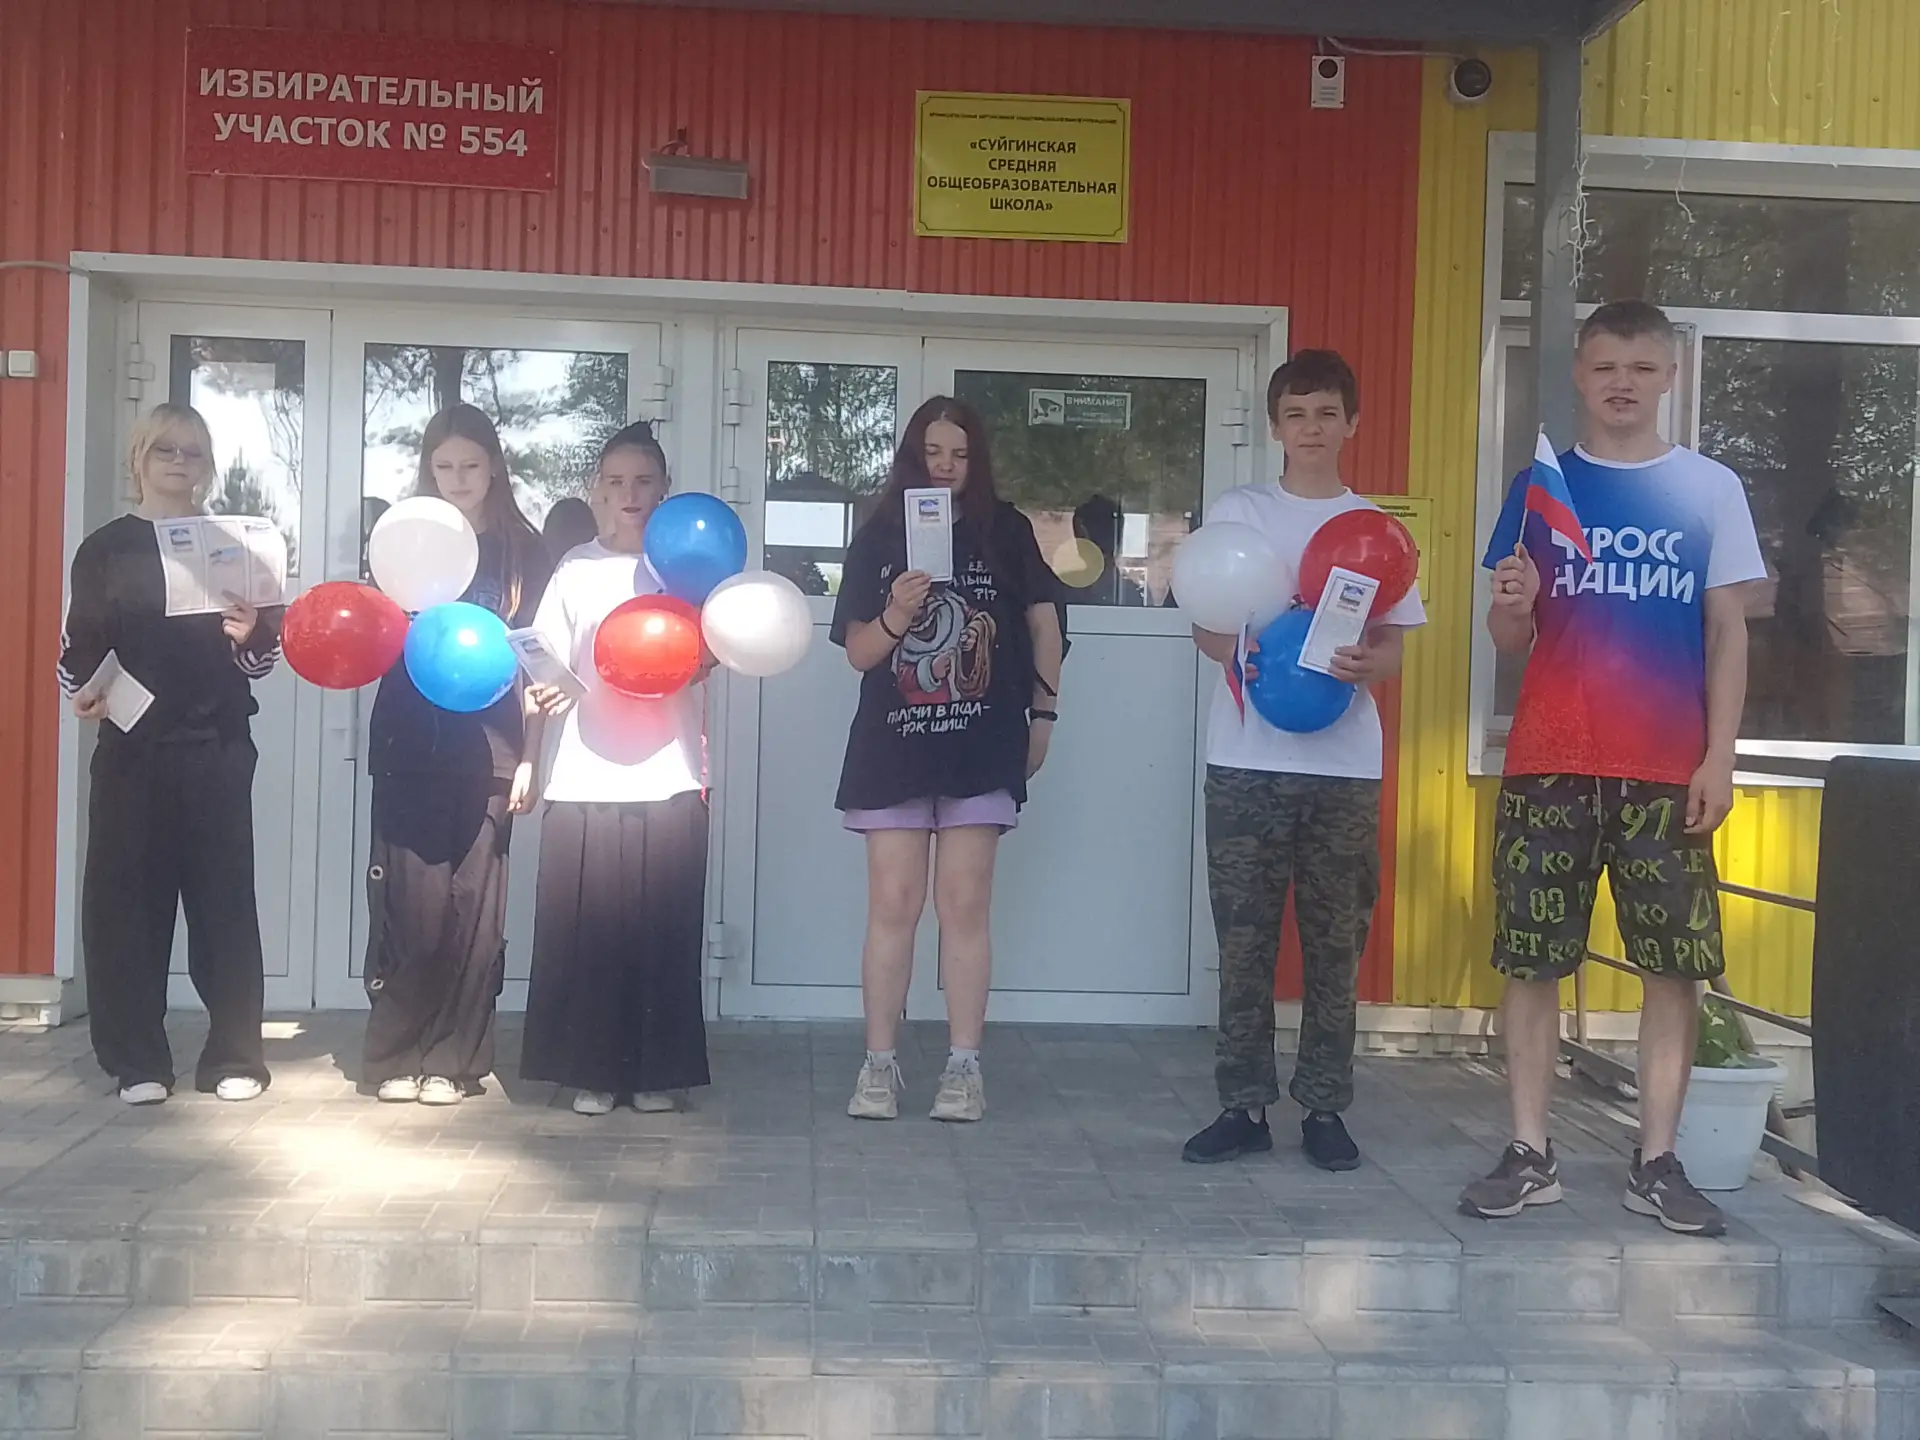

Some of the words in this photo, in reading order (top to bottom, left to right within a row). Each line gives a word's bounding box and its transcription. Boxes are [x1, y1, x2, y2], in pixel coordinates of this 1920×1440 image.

[199, 67, 544, 115] ИЗБИРАТЕЛЬНЫЙ
[213, 112, 391, 149] УЧАСТОК
[403, 121, 446, 151] №
[459, 126, 528, 157] 554
[970, 135, 1077, 154] «СУЙГИНСКАЯ
[988, 158, 1057, 174] СРЕДНЯЯ
[926, 175, 1117, 195] ОБЩЕОБРАЗОВАТЕЛЬНАЯ
[989, 197, 1054, 212] ШКОЛА»
[1550, 561, 1695, 605] НАЦИИ
